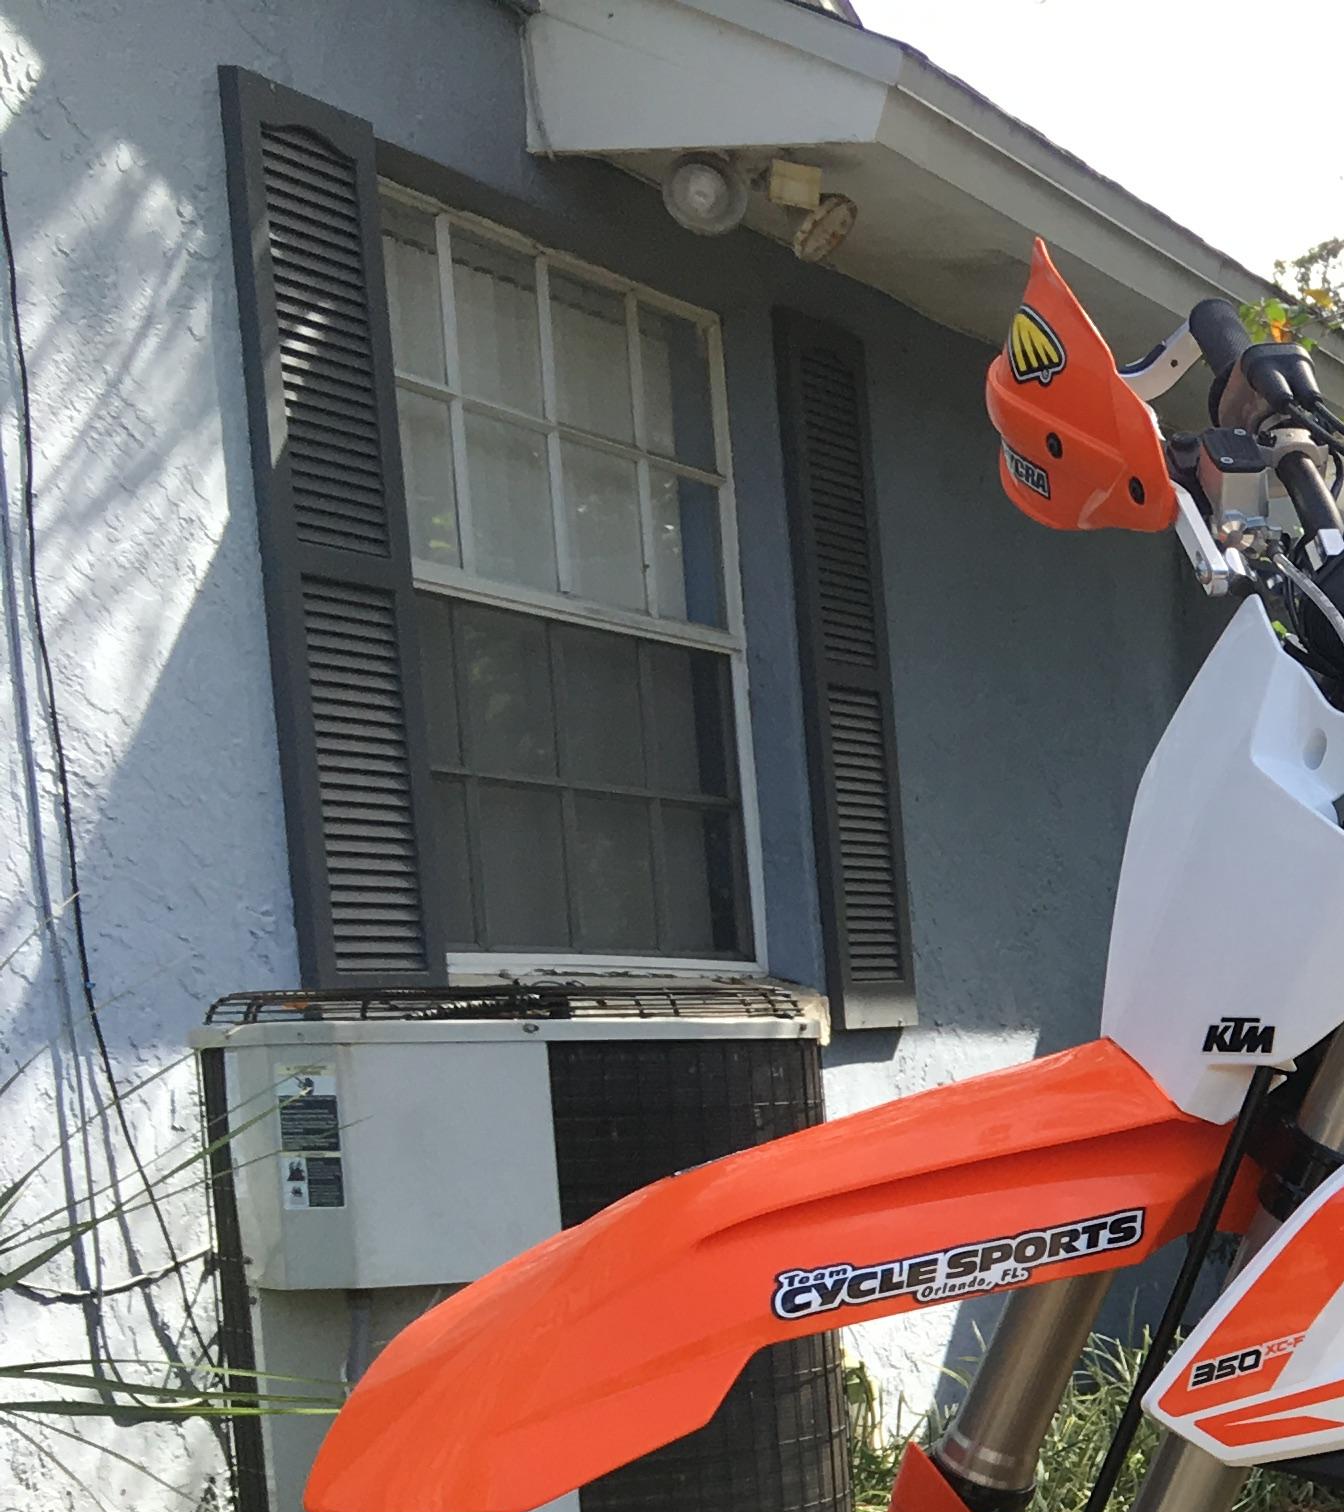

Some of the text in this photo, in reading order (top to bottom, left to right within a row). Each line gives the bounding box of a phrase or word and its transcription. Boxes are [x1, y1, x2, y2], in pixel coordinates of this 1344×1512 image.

[1202, 1017, 1275, 1053] KTM
[784, 1268, 848, 1287] Team
[921, 1275, 993, 1298] Orlando,
[1191, 1349, 1262, 1387] 350
